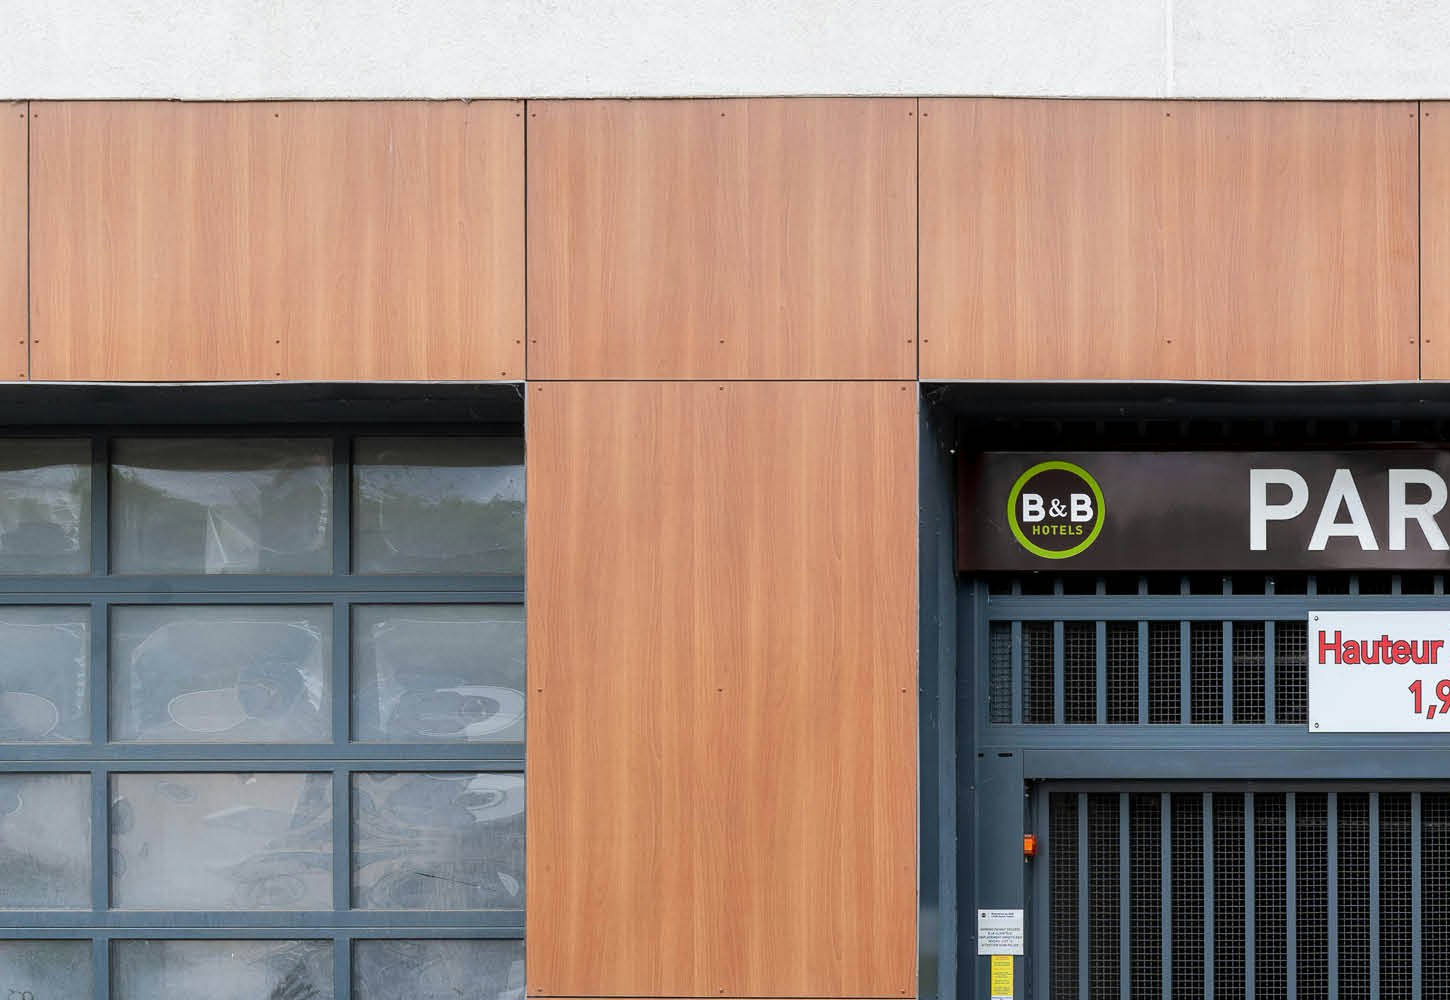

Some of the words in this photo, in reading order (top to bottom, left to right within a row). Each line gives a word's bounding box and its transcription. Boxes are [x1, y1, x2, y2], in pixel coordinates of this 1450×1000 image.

[1022, 493, 1094, 522] B&B
[1032, 525, 1083, 536] HOTELS
[1318, 630, 1444, 665] Hauteur
